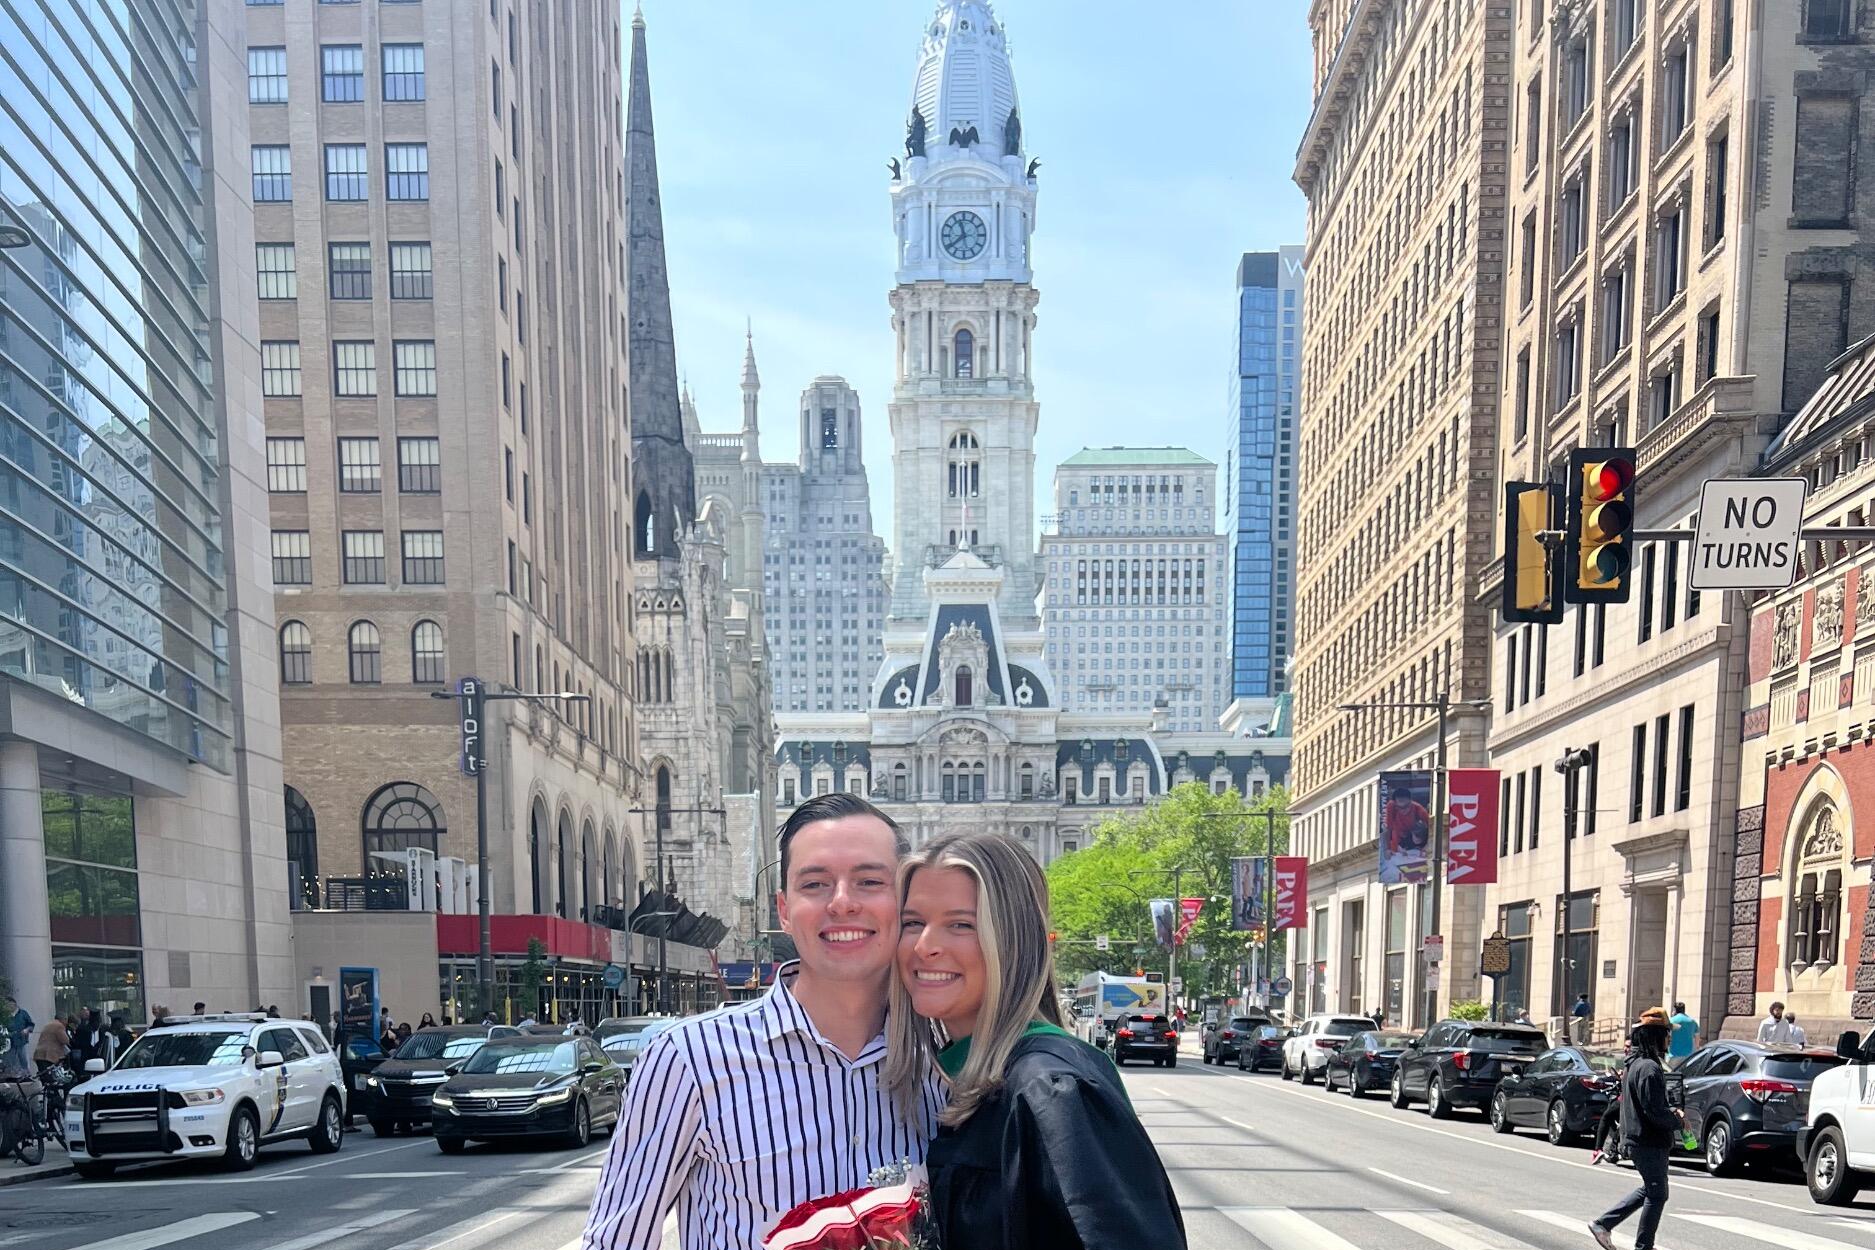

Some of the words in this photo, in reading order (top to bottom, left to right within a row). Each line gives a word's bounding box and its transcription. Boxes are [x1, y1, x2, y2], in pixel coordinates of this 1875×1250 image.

[1723, 495, 1777, 529] NO
[1702, 541, 1789, 569] TURNS
[463, 681, 478, 771] aloft
[1448, 793, 1479, 882] PAFA
[1276, 872, 1296, 929] PAFA
[100, 1083, 166, 1093] POLICE
